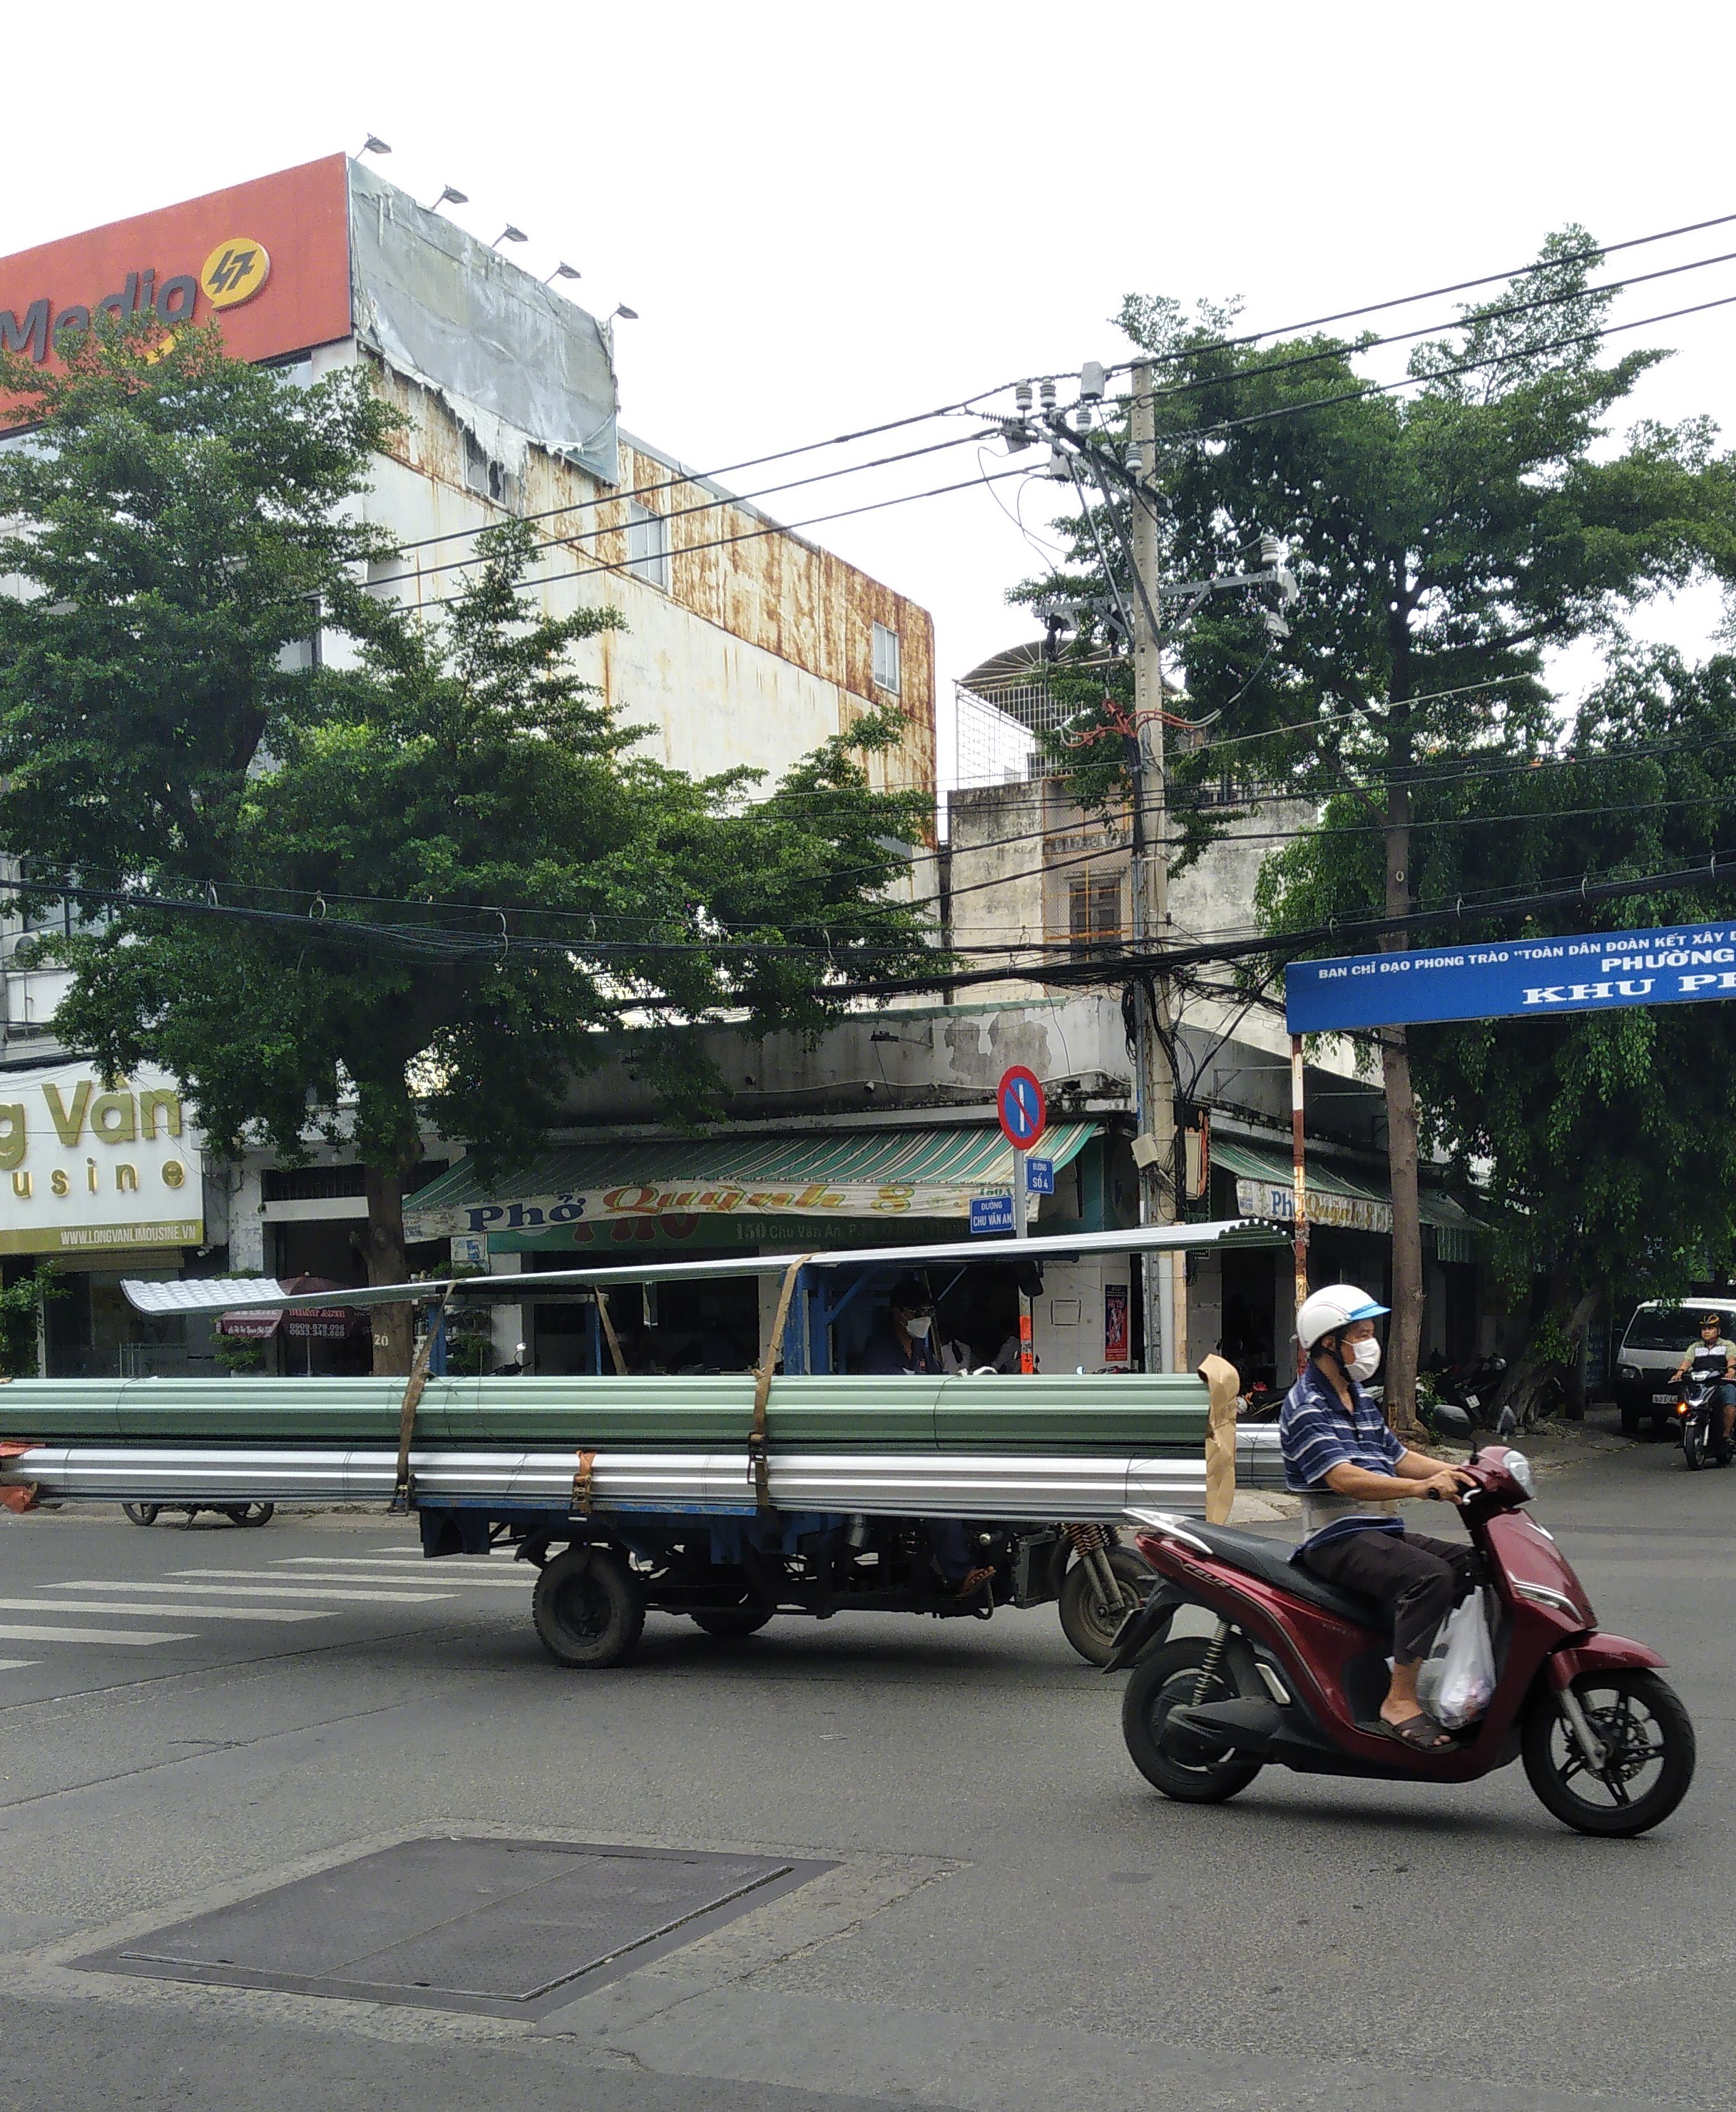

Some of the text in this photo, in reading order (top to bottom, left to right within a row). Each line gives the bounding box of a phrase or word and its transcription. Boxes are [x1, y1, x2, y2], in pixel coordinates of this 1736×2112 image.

[0, 268, 197, 363] Media
[1318, 967, 1347, 979] BAN
[1380, 961, 1411, 974] ĐẠO
[1414, 956, 1464, 969] PHONG
[1468, 950, 1509, 964] TRÀO
[1568, 942, 1601, 956] DÂN
[1606, 937, 1650, 952] ĐOÀN
[1655, 932, 1688, 947] KẾT
[1692, 930, 1725, 945] XÂY
[1601, 948, 1735, 972] PHƯỜNG
[1522, 978, 1656, 1005] KHU
[1032, 1173, 1048, 1189] SỐ 4
[464, 1194, 587, 1233] Phở
[870, 1184, 915, 1213] 8
[1271, 1190, 1296, 1217] Ph
[973, 1213, 1012, 1227] CHU VĂN AN
[61, 1225, 196, 1245] WWW.LONGVANLIMOUSINE.VN
[374, 1334, 389, 1347] 20
